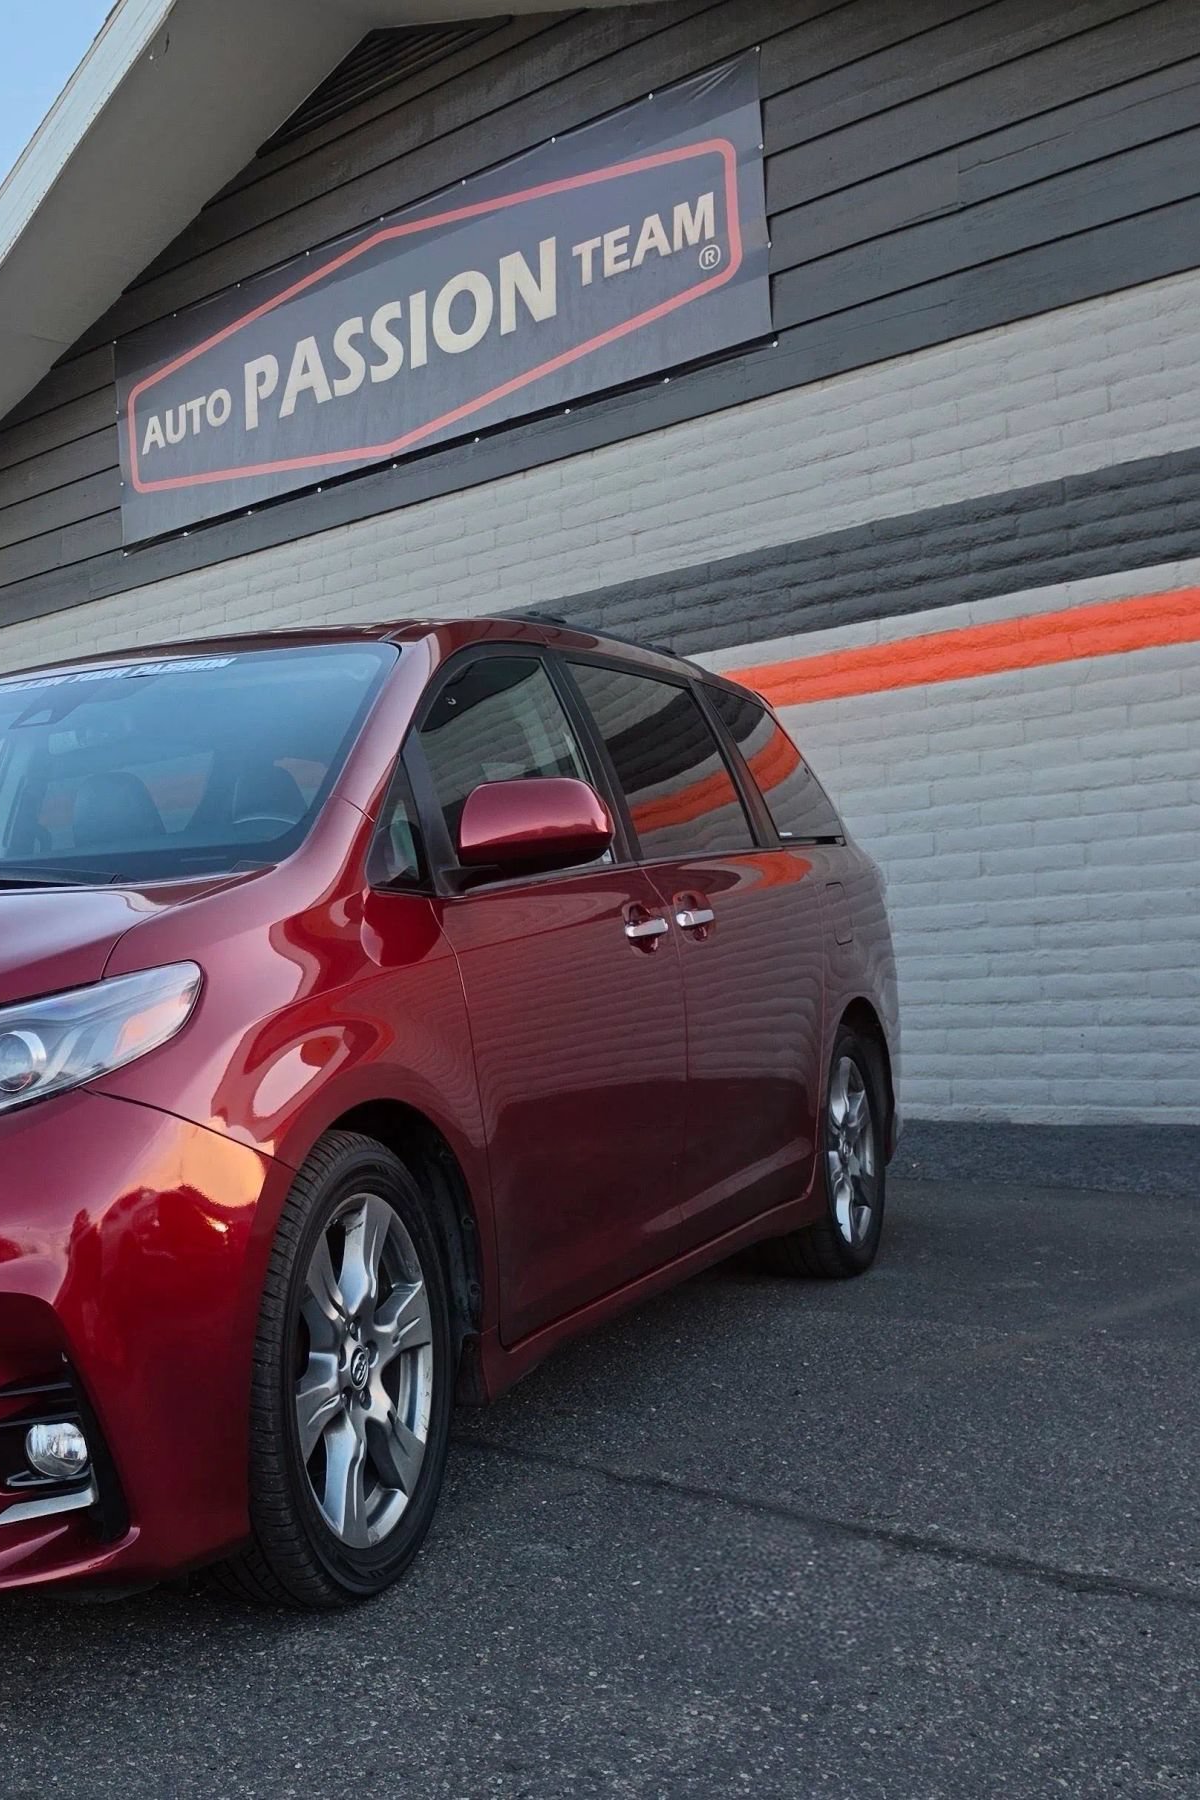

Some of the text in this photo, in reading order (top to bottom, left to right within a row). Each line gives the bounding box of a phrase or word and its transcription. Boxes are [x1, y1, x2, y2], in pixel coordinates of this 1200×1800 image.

[141, 388, 232, 455] AUTO
[243, 236, 558, 430] PASSION
[573, 191, 715, 287] TEAM
[132, 657, 238, 676] PASSION
